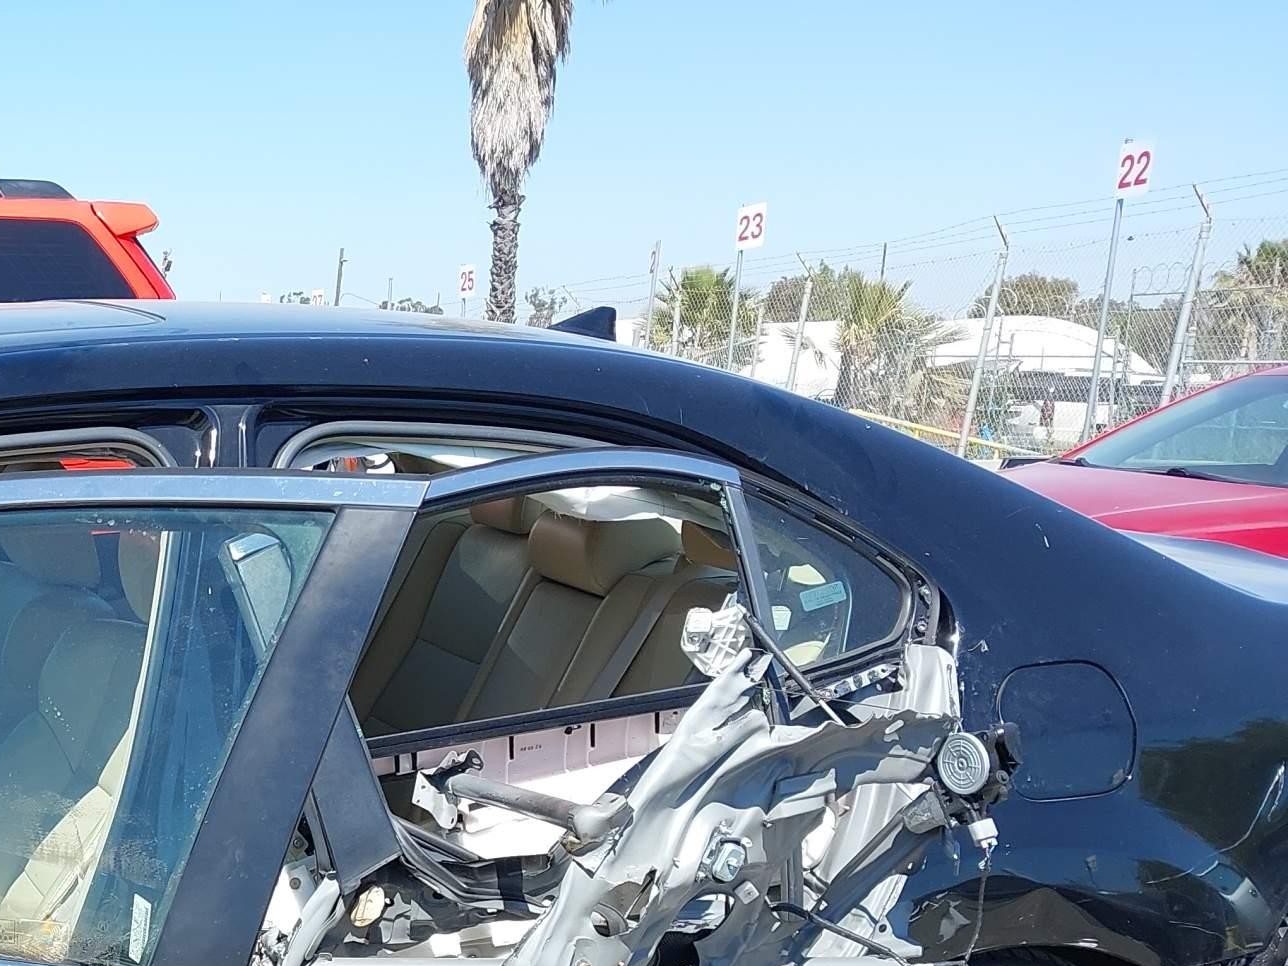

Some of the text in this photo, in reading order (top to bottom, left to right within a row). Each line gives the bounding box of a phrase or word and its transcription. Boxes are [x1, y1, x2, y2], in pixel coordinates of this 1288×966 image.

[1118, 150, 1151, 189] 22
[738, 212, 763, 242] 23
[460, 270, 474, 292] 25
